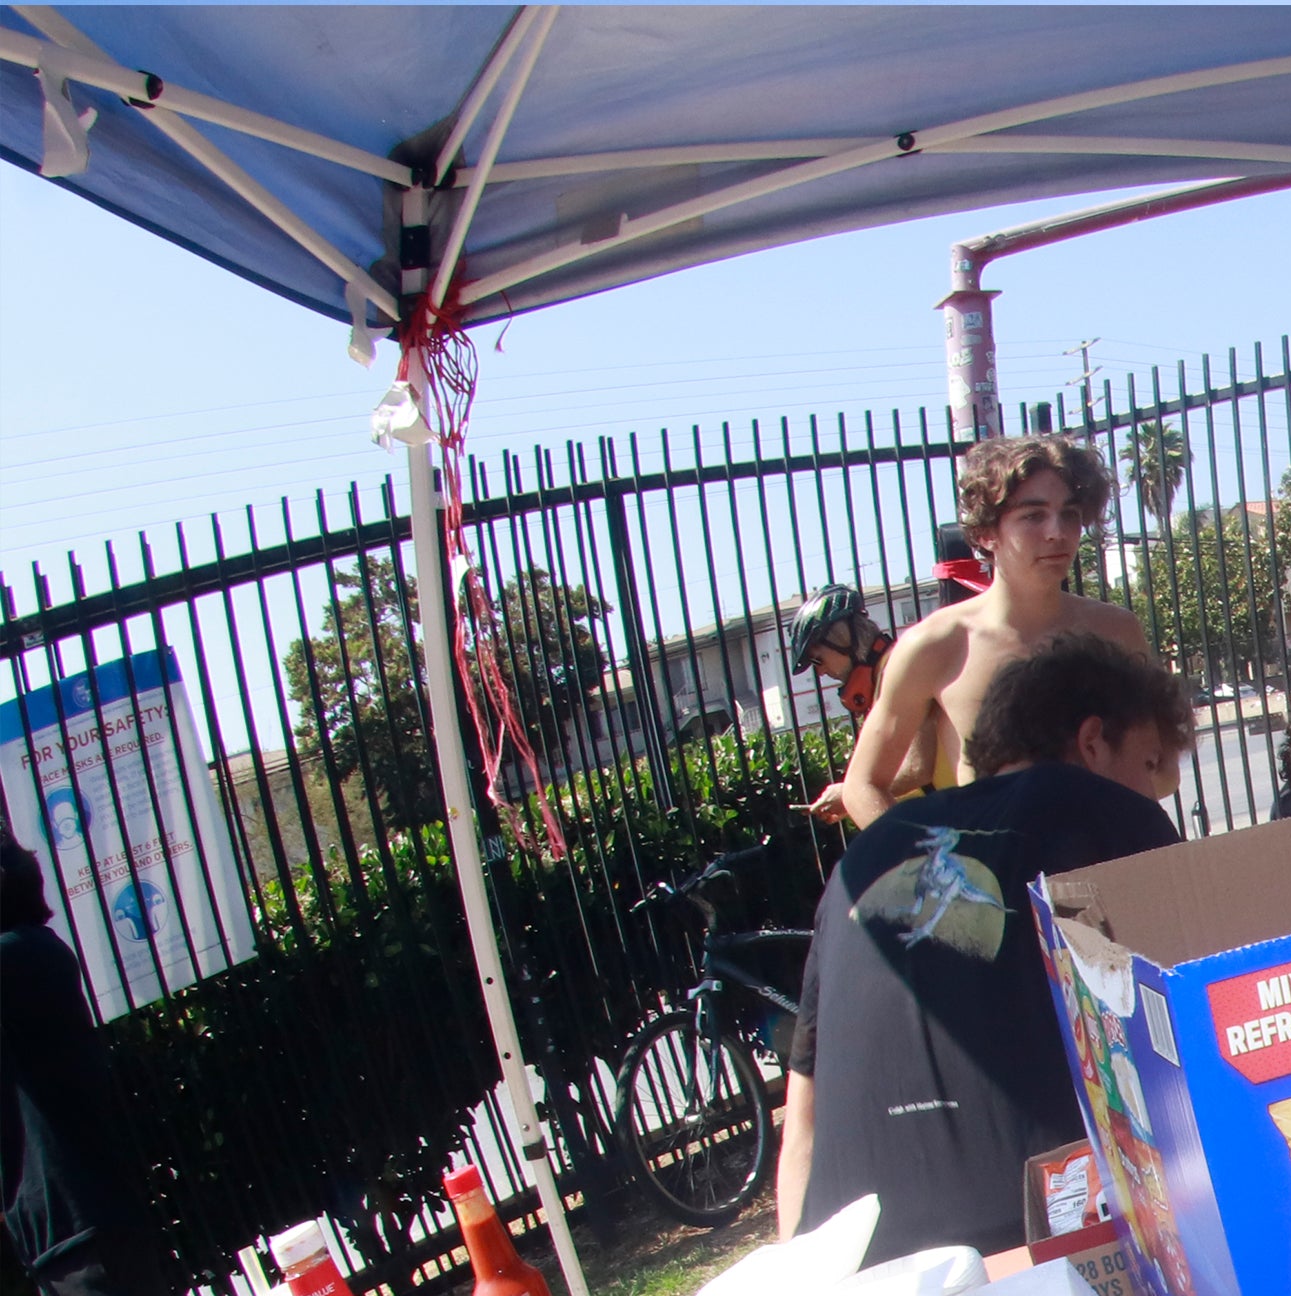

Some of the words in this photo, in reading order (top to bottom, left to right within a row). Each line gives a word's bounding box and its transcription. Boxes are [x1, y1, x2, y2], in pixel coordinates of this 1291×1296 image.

[21, 746, 53, 770] FOR
[55, 727, 101, 755] YOUR
[62, 758, 93, 778] MSKS
[95, 751, 113, 764] AE
[115, 732, 164, 754] REQURED.
[67, 873, 111, 897] BETWEN
[154, 840, 193, 862] OTERS.
[78, 860, 101, 878] KEP
[104, 855, 114, 868] AT
[116, 843, 144, 863] LEST
